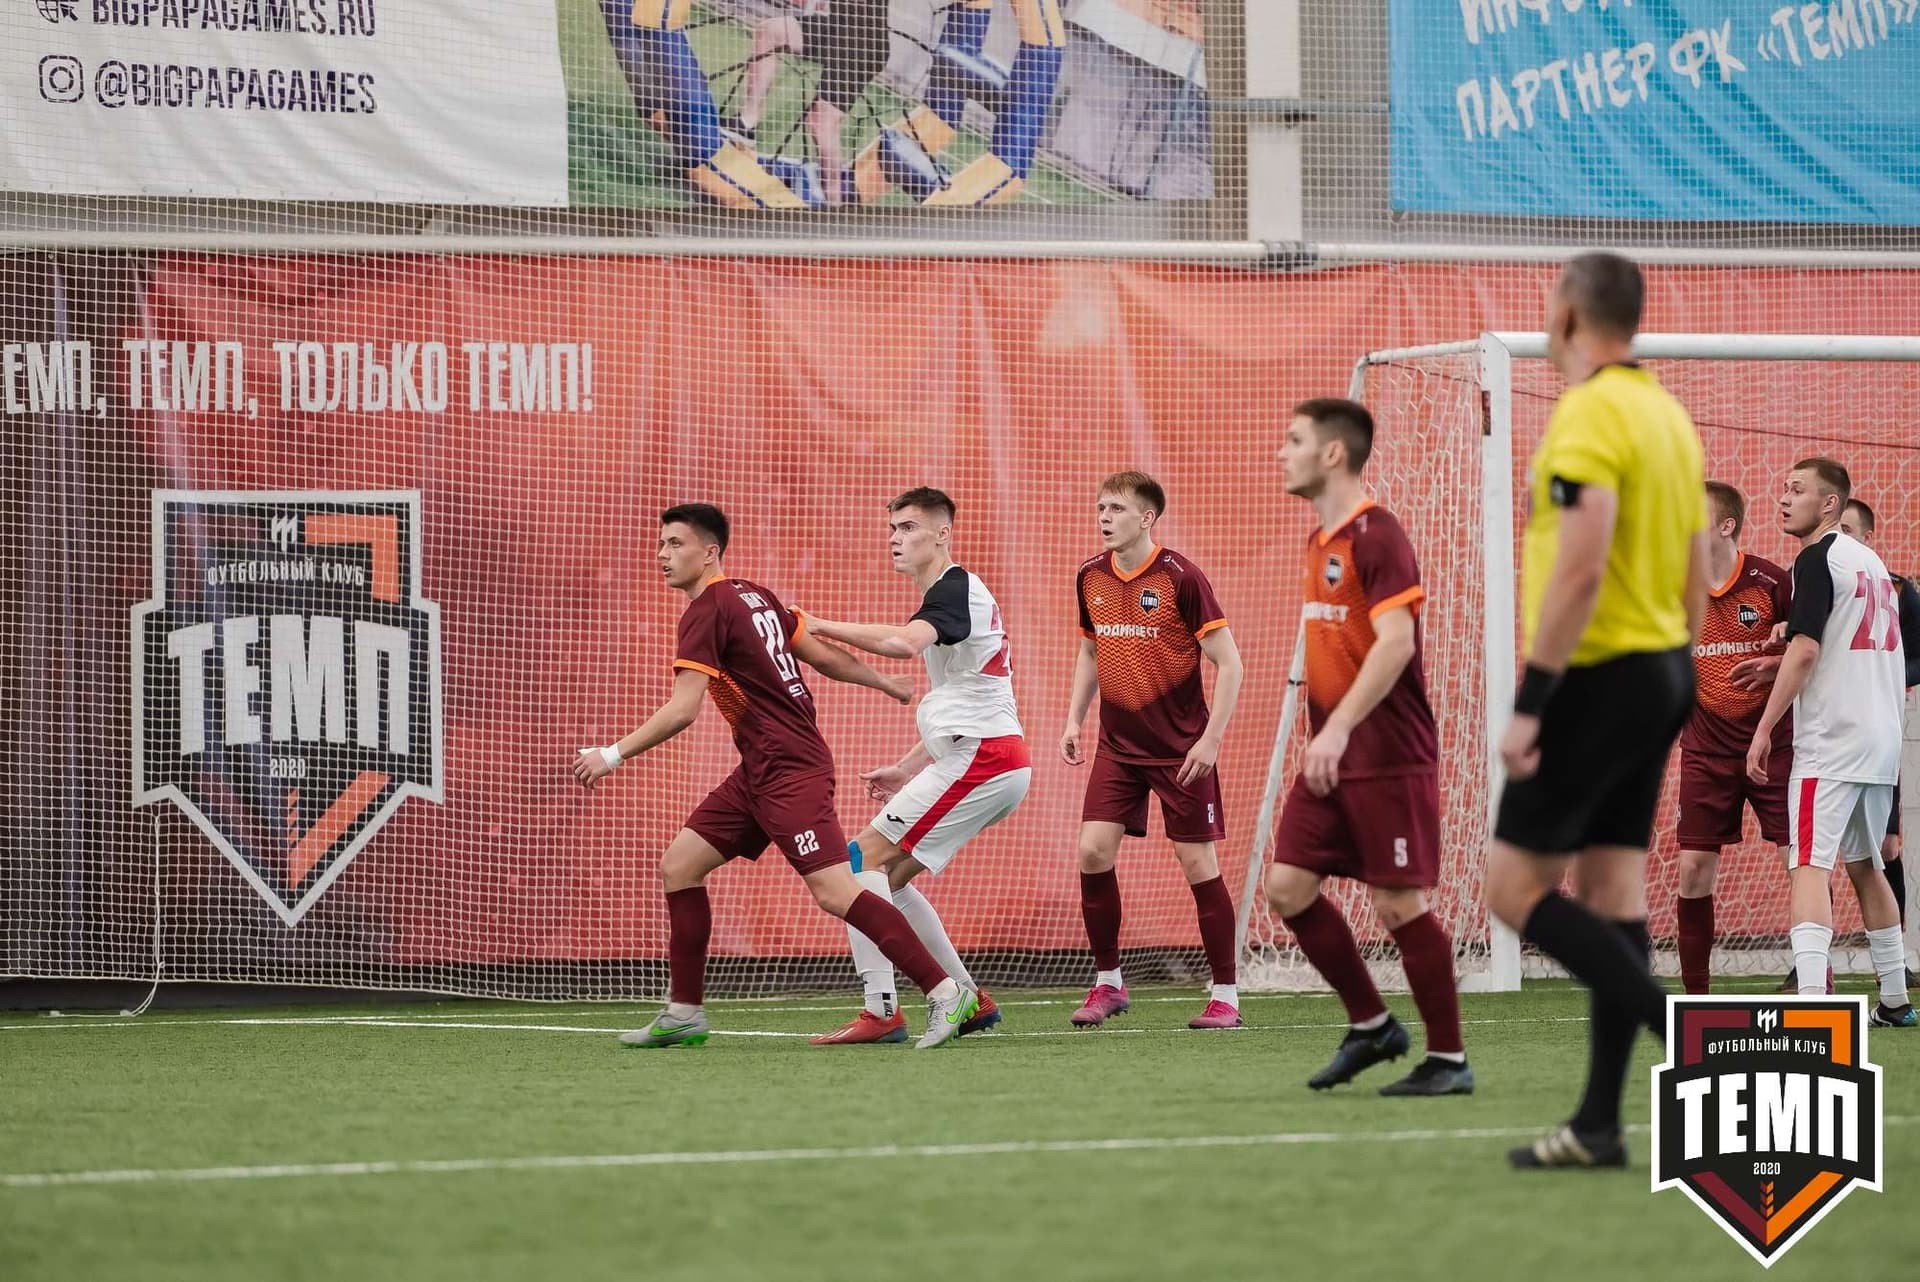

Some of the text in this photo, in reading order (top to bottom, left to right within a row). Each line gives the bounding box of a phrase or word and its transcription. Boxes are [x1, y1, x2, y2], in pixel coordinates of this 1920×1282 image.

[95, 60, 377, 113] @BIGPAPAGAMES
[1456, 42, 1655, 142] ПАРТНЕР
[1669, 19, 1746, 89] ФК
[122, 341, 258, 420] ТЕМП,
[273, 341, 448, 414] ТОЛЬКО
[462, 342, 593, 413] ТЕМП!
[207, 556, 365, 586] ФУТБОЛЬНЫЙ КЛУБ
[752, 610, 799, 682] 22
[167, 614, 411, 756] ТЕМП
[269, 758, 306, 778] 2020
[794, 829, 820, 857] 22
[1393, 837, 1408, 868] 5
